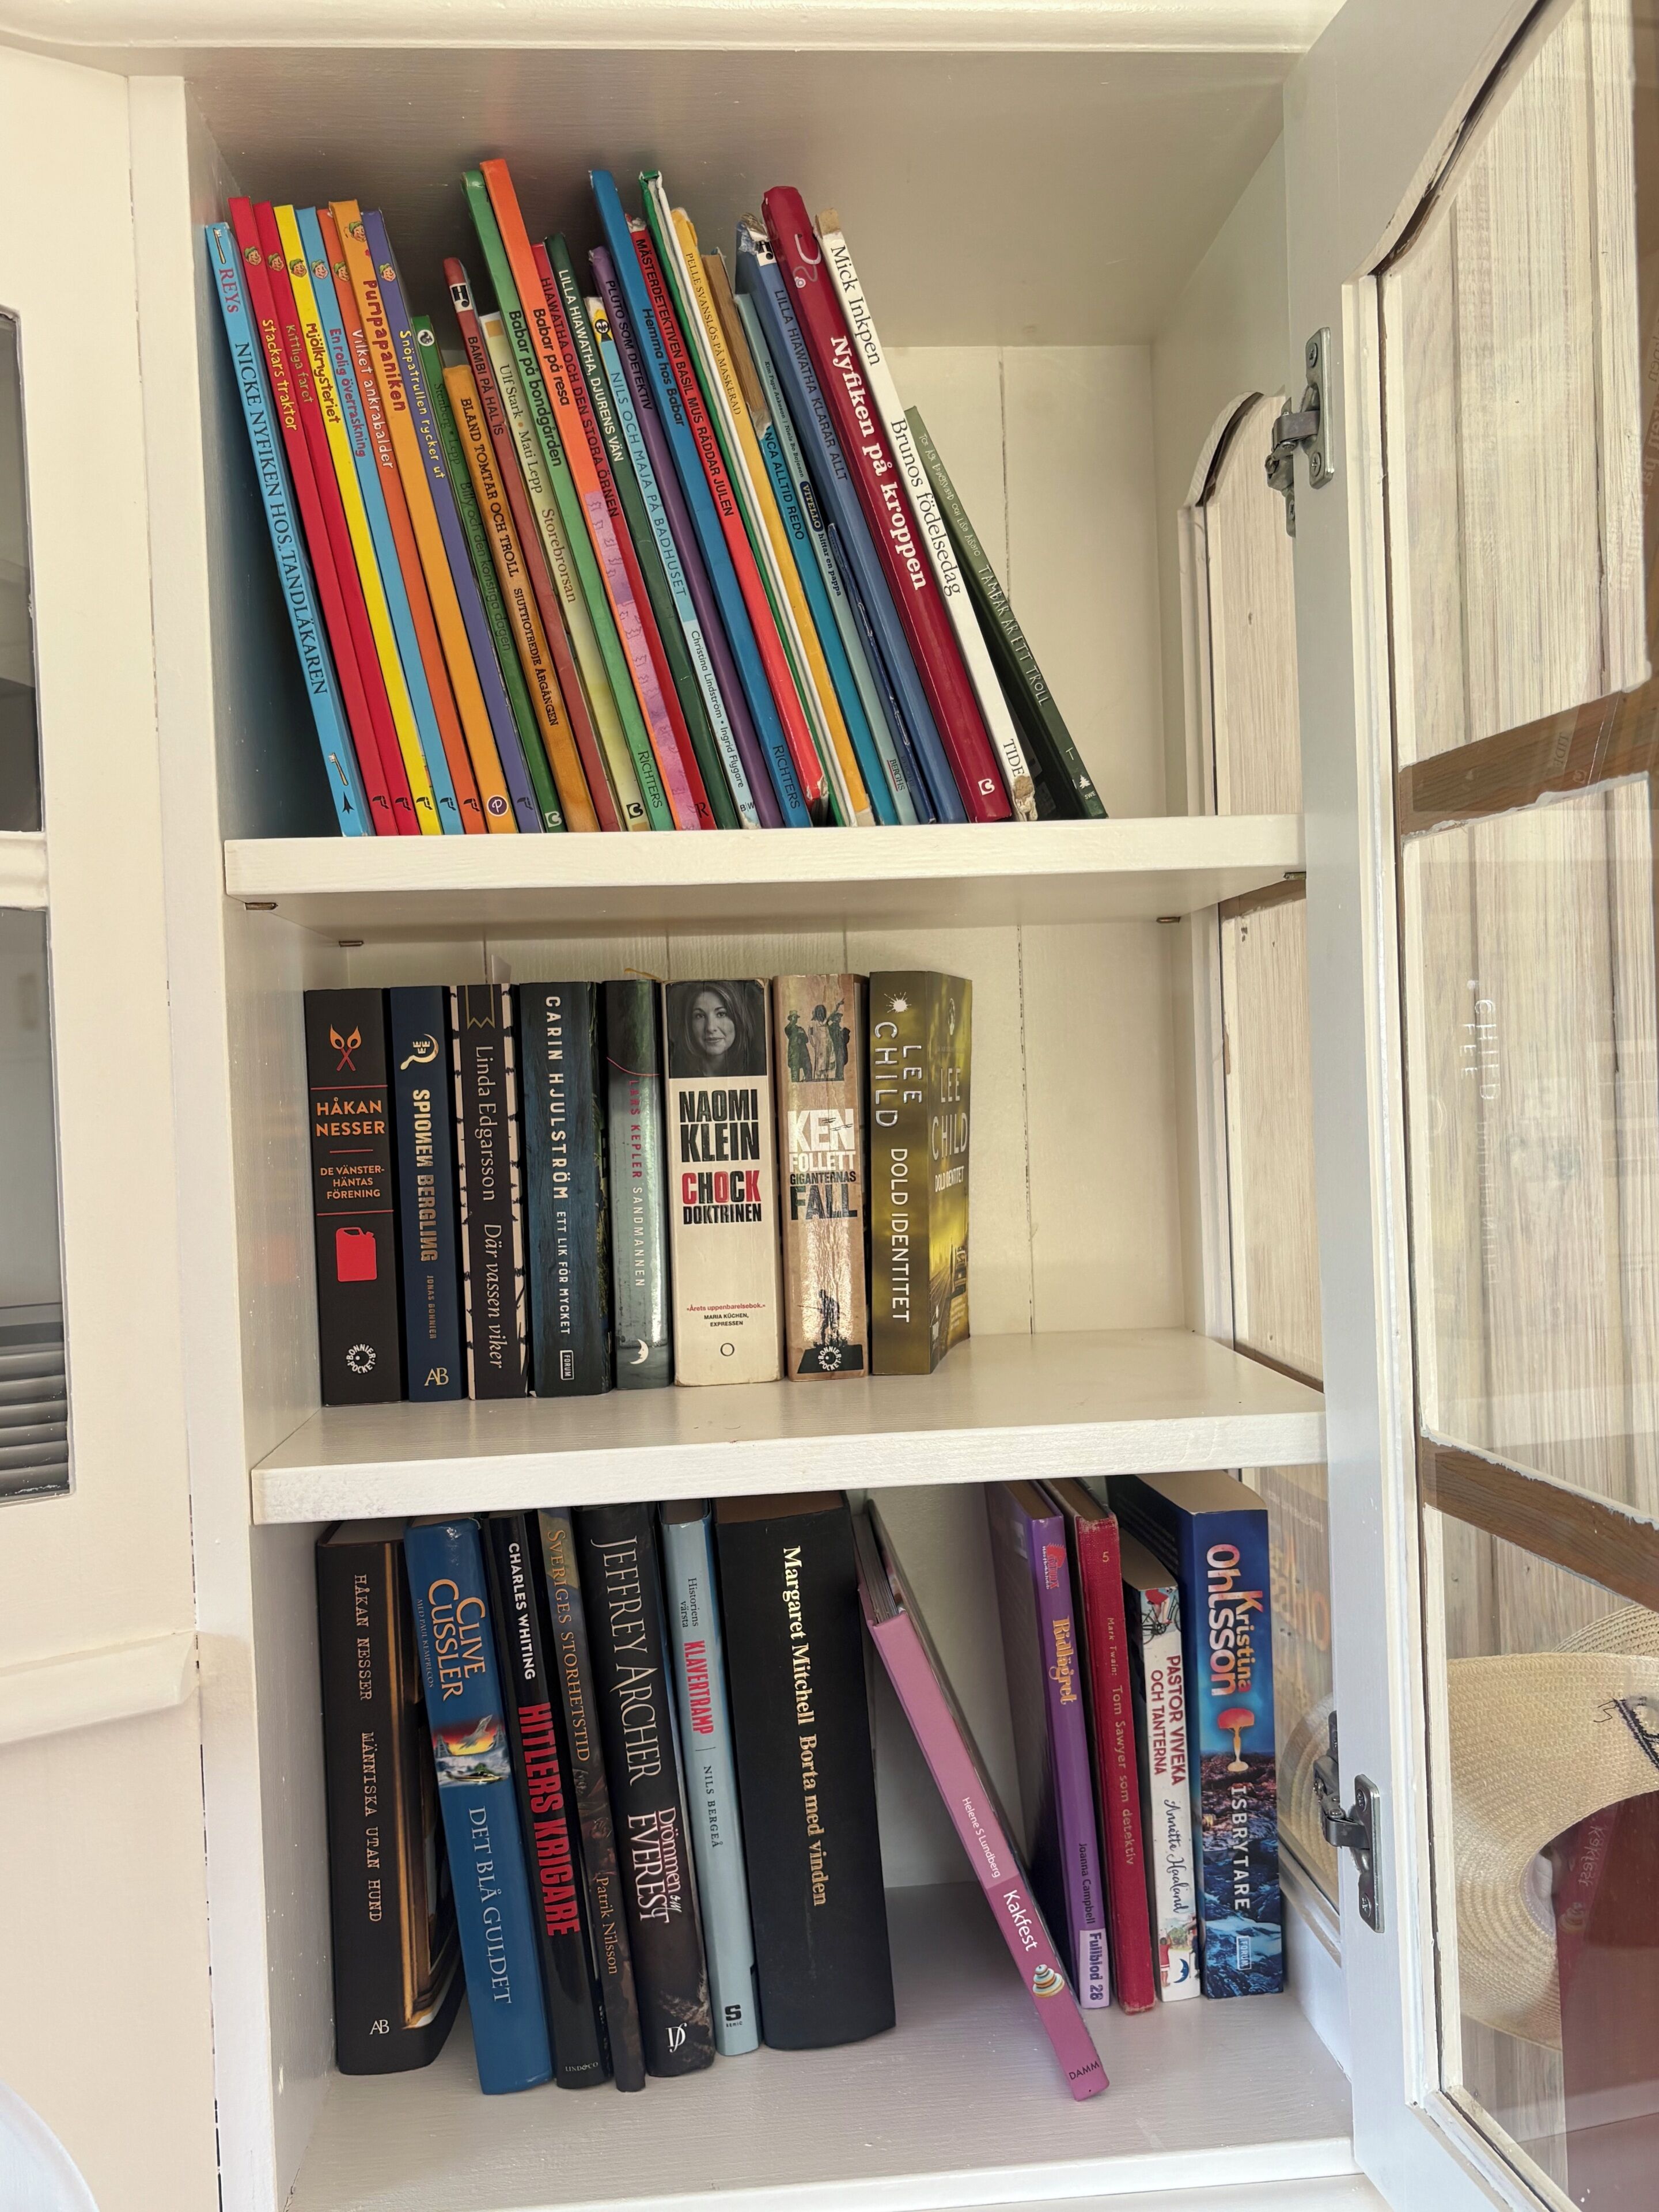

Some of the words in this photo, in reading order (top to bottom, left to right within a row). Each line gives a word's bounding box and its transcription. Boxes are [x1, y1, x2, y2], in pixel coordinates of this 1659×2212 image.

[508, 310, 529, 353] Babar
[533, 309, 554, 353] Babar
[605, 280, 625, 319] PLUTO
[619, 321, 635, 351] SOM
[830, 244, 859, 294] Mick
[848, 296, 881, 367] Inkpen
[467, 336, 487, 376] BAMBI
[499, 363, 513, 385] Ulf
[518, 358, 539, 377] på
[544, 355, 563, 374] på
[558, 269, 577, 305] LILLA
[569, 306, 597, 377] HIAWATHA,
[590, 377, 615, 435] DJURENS
[607, 435, 624, 463] VÄN
[635, 238, 684, 360] MÄSTERDETEKTIVEN
[675, 360, 695, 401] BASIL
[687, 396, 704, 425] MUS
[696, 426, 721, 476] RÄDDAR
[713, 478, 735, 517] JULEN
[642, 308, 664, 360] Hemma
[657, 362, 672, 385] hos
[665, 386, 685, 428] Babar
[276, 380, 297, 431] traktor
[399, 329, 428, 416] Snöpatrullen
[420, 418, 440, 461] rycker
[432, 464, 446, 479] ut
[480, 379, 494, 394] PÅ
[484, 396, 499, 422] HAL
[505, 386, 521, 419] Stark
[552, 377, 570, 406] resa
[563, 354, 580, 384] OCH
[573, 387, 589, 416] DEN
[582, 416, 603, 465] STORA
[774, 289, 794, 325] LILLA
[787, 327, 817, 394] HIAWATHA
[811, 397, 836, 449] KLARAR
[830, 452, 848, 483] ALLT
[342, 378, 367, 457] överraskning
[363, 378, 394, 469] ankrabalder
[518, 430, 533, 460] Mati
[528, 380, 562, 467] bondgården
[460, 397, 482, 442] BLAND
[474, 443, 498, 501] TOMTAR
[490, 502, 508, 534] OCH
[499, 535, 519, 578] TROLL
[526, 462, 543, 494] Lepp
[610, 371, 628, 404] NILS
[622, 410, 641, 444] OCH
[634, 450, 653, 489] MAJA
[654, 518, 687, 597] BADHUSET
[830, 335, 876, 438] Nyfiken
[861, 442, 893, 476] på
[880, 480, 927, 591] kroppen
[235, 342, 262, 407] NICKE
[250, 411, 282, 497] NYFIKEN
[281, 550, 327, 695] TANDLÄKAREN
[772, 461, 793, 503] ALLTID
[786, 506, 805, 541] REDO
[890, 417, 923, 487] Brunos
[915, 491, 961, 597] födelsedag
[542, 509, 577, 603] Storebrorsan
[691, 629, 709, 672] Christina
[703, 673, 722, 719] Lindström
[719, 726, 734, 753] Ingrid
[727, 753, 745, 789] Flygare
[546, 996, 563, 1060] CARIN
[476, 1046, 496, 1097] Linda
[874, 1021, 899, 1128] CHILD
[903, 1045, 922, 1104] LEE
[940, 1067, 961, 1104] LEE
[316, 1097, 382, 1116] HÅKAN
[316, 1120, 385, 1137] NESSER
[412, 1089, 434, 1167] SPIONEN
[679, 1089, 759, 1123] NAOMI
[787, 1108, 855, 1152] KEN
[475, 1103, 498, 1201] Edgarsson
[548, 1073, 571, 1199] HJULSTRÖM
[631, 1124, 643, 1179] KEPLER
[680, 1122, 760, 1162] KLEIN
[789, 1151, 856, 1173] FOLLETT
[931, 1112, 968, 1161] CHILD
[320, 1166, 334, 1176] DE
[336, 1164, 385, 1176] VÄNSTER-
[327, 1188, 380, 1199] FÖRENING
[332, 1177, 373, 1187] HÄNTAS
[681, 1170, 761, 1205] CHOCK
[790, 1171, 857, 1185] GIGANTERNAS
[890, 1148, 908, 1206] DOLD
[417, 1175, 438, 1262] BERGLING
[556, 1211, 567, 1233] ETT
[683, 1203, 762, 1225] DOKTRINEN
[790, 1183, 858, 1220] FALL
[483, 1223, 503, 1257] Där
[556, 1237, 568, 1257] LIK
[632, 1187, 645, 1287] SANDMANNEN
[485, 1262, 501, 1319] vassen
[891, 1213, 910, 1323] IDENTITET
[559, 1287, 570, 1335] MYCKET
[487, 1323, 507, 1369] viker
[354, 1573, 370, 1628] HÅKAN
[508, 1542, 528, 1611] CHARLES
[687, 1577, 699, 1627] Historiens
[782, 1545, 807, 1641] Margaret
[428, 1578, 464, 1702] CUSSLER
[517, 1613, 536, 1681] WHITING
[1206, 1544, 1241, 1696] Ohlsson
[357, 1637, 373, 1701] NESSER
[684, 1640, 715, 1735] KLAVERTRAMP
[791, 1642, 815, 1726] Mitchell
[1150, 1669, 1165, 1702] OCH
[1166, 1655, 1184, 1724] PASTOR
[1112, 1685, 1123, 1715] Tom
[517, 1702, 565, 1813] HITLERS
[799, 1733, 819, 1791] Borta
[1114, 1720, 1126, 1769] Sawyer
[1152, 1706, 1168, 1776] TANTERNA
[1169, 1725, 1187, 1786] VIVEKA
[361, 1731, 378, 1817] MÄNNISKA
[703, 1765, 715, 1796] NILS
[1119, 1775, 1130, 1802] som
[468, 1805, 493, 1854] DET
[707, 1800, 724, 1849] BERGEÅ
[804, 1794, 825, 1837] med
[961, 1796, 980, 1829] Helene
[978, 1835, 1001, 1879] Lundberg
[1122, 1808, 1135, 1866] detektiv
[1164, 1798, 1182, 1854] Annette
[365, 1826, 380, 1869] UTAN
[627, 1810, 671, 1925] EVEREST
[658, 1806, 682, 1894] Drömmen
[808, 1839, 829, 1907] vinden
[368, 1878, 382, 1923] HUND
[476, 1859, 502, 1903] BLÅ
[533, 1817, 582, 1937] KRIGARE
[596, 1876, 615, 1919] Patrik
[1082, 1878, 1096, 1925] Campbell
[1166, 1853, 1190, 1914] Haaland
[602, 1921, 618, 1975] Nilsson
[1003, 1889, 1039, 1952] Kakfest
[483, 1906, 513, 2005] GULDET
[1089, 1984, 1104, 2001] 28
[1069, 2060, 1100, 2081] DAMM
